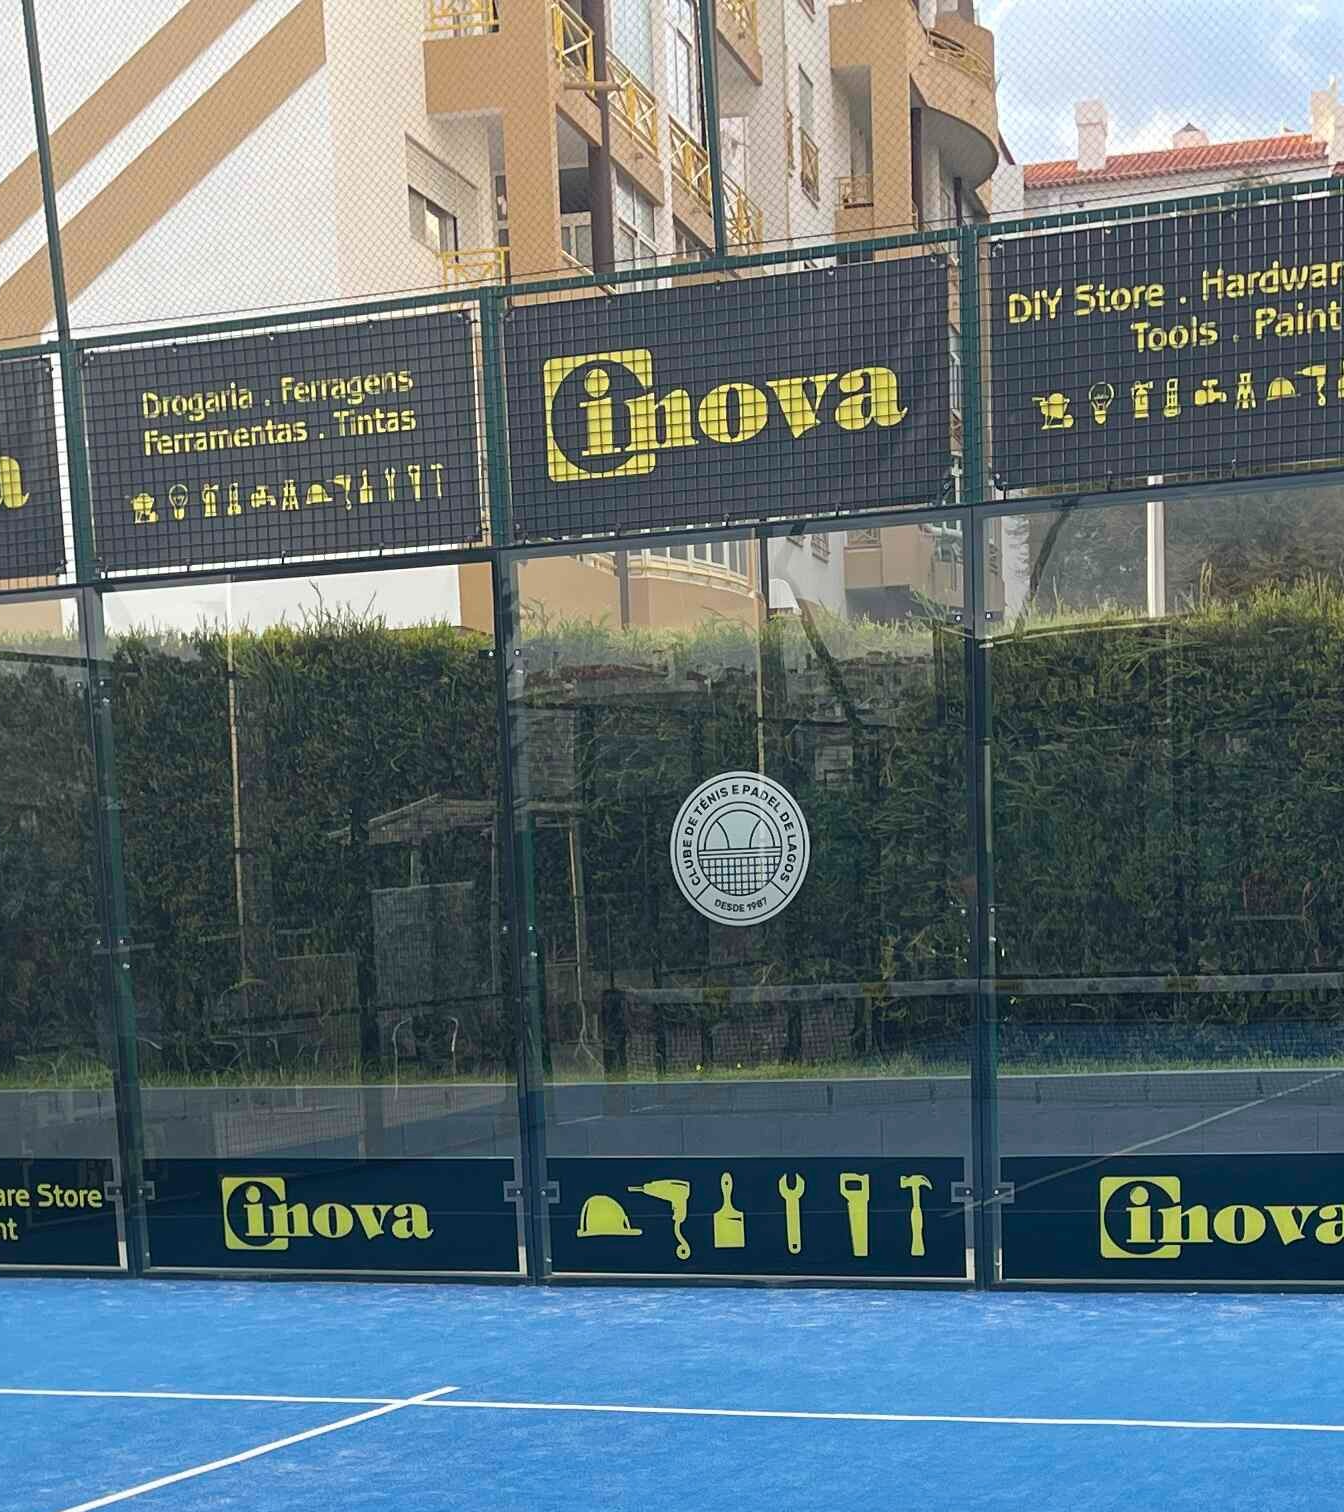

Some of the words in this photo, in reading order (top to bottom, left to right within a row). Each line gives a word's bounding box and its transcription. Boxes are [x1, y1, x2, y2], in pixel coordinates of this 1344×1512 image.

[1008, 288, 1061, 324] DIY
[1073, 282, 1165, 317] Store
[1130, 315, 1218, 353] Tools
[1255, 300, 1342, 340] Paint
[142, 381, 253, 421] Drogaria
[280, 369, 414, 405] Ferragens
[143, 418, 308, 457] Ferramentas
[333, 407, 418, 437] Tintas
[731, 784, 740, 795] E
[742, 784, 782, 813] PADEL
[684, 815, 698, 836] DE
[779, 811, 795, 832] DE
[682, 839, 701, 887] CLUBE
[779, 833, 797, 883] LAGOS
[714, 898, 746, 913] DESDE
[746, 896, 769, 912] 1987
[36, 1183, 103, 1208] Store
